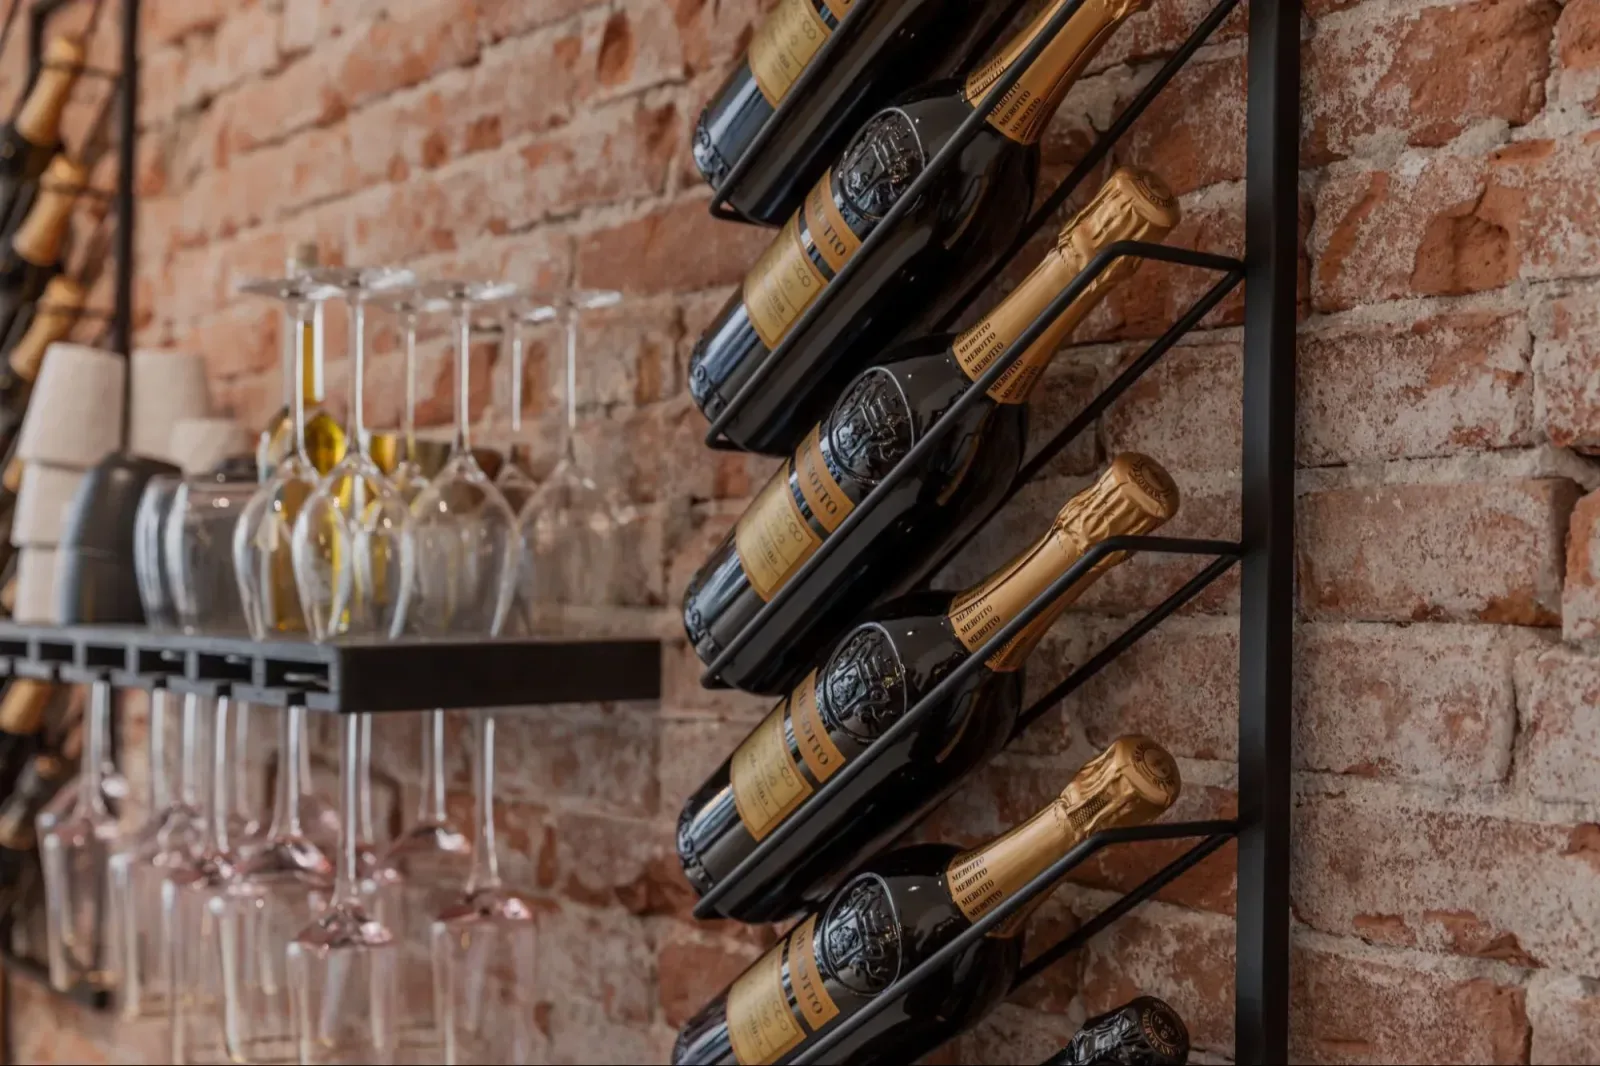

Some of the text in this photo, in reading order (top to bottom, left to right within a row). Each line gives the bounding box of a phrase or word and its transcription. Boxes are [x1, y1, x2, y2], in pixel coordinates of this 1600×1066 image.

[999, 90, 1031, 127] MEROTTO
[958, 322, 991, 355] MEROTTO
[963, 331, 997, 366] MEROTTO
[970, 341, 1004, 376] MEROTTO
[989, 359, 1024, 394] MEROTTO
[960, 604, 993, 635] MEROTTO
[967, 614, 1001, 646] MEROTTO
[951, 856, 985, 883] MEROTTO
[955, 867, 988, 895] MEROTTO
[961, 879, 995, 908] MEROTTO
[968, 889, 1003, 918] MEROTTO
